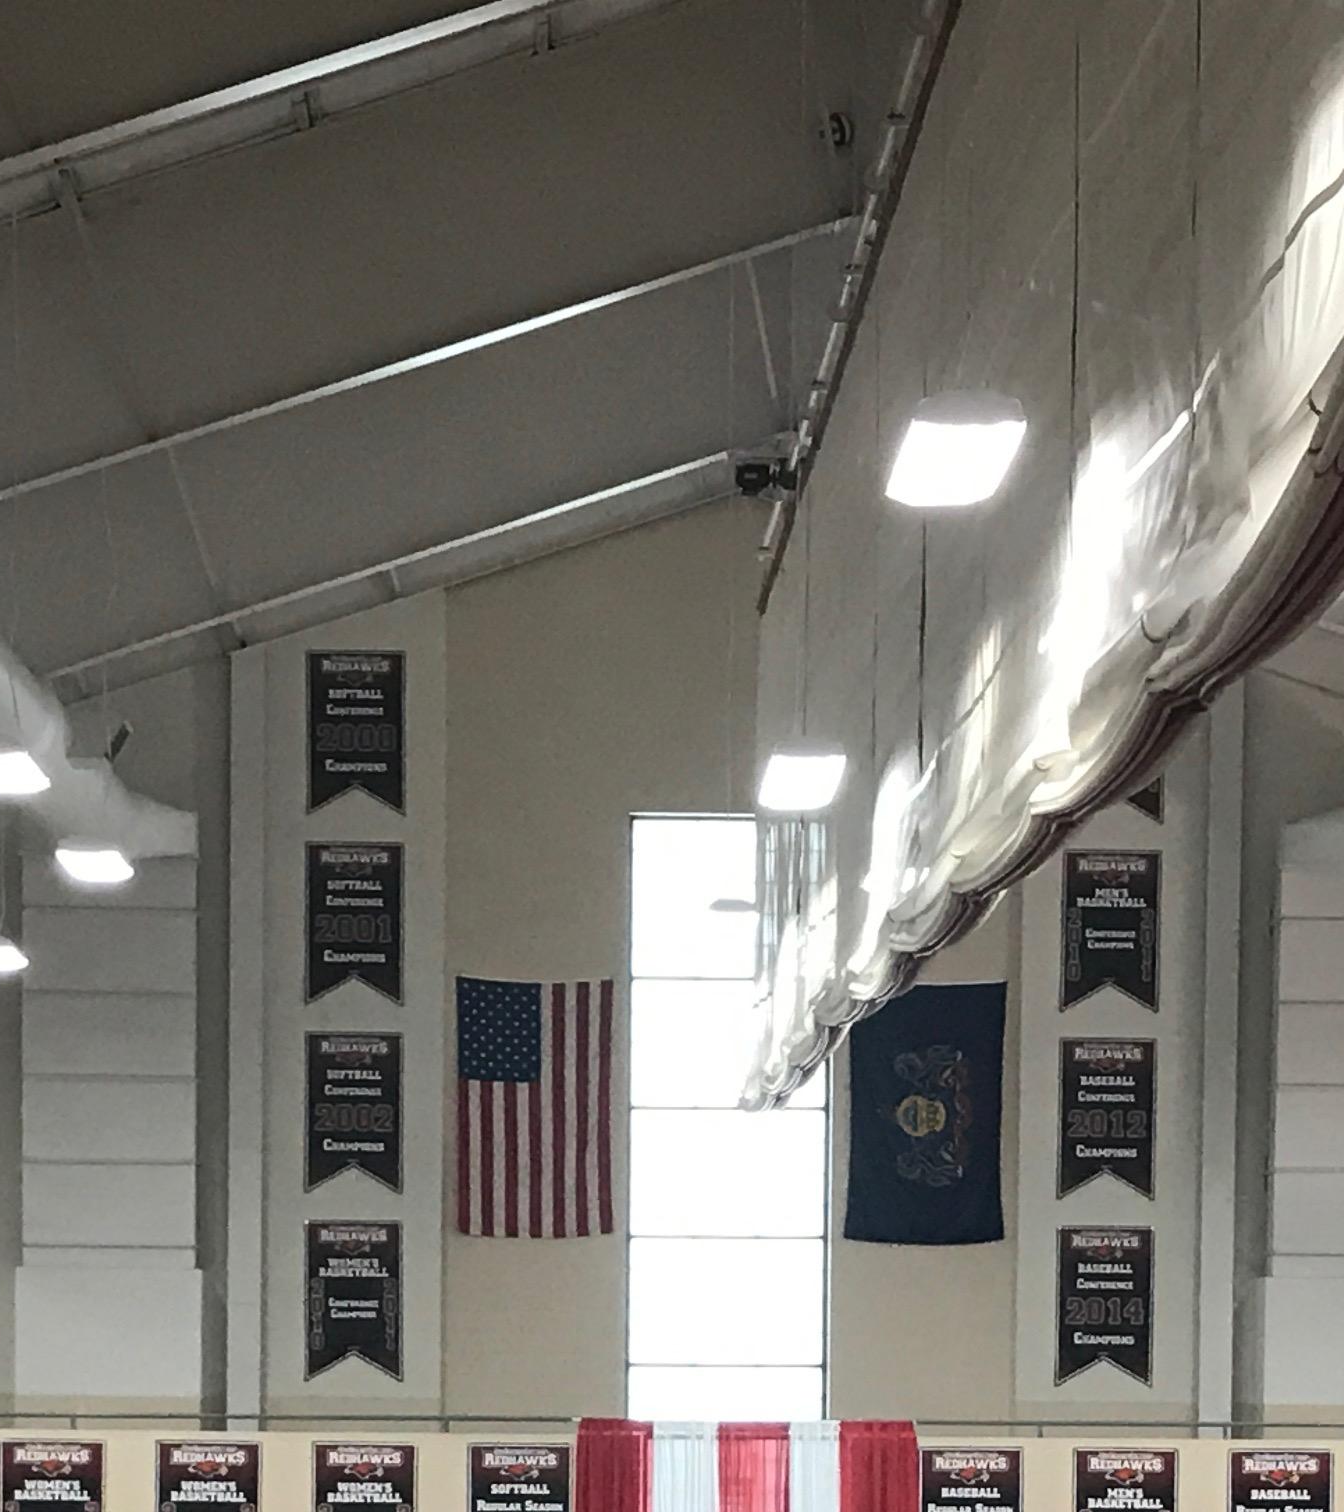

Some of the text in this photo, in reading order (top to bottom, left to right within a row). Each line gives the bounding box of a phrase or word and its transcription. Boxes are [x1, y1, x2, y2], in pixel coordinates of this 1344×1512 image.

[1068, 1110, 1148, 1137] 2012
[1066, 1297, 1145, 1324] 2014
[491, 1484, 550, 1494] SOFTBALL
[941, 1487, 1000, 1498] BASEBALL
[14, 1490, 91, 1501] BASKETBALL
[171, 1492, 246, 1502] BASKETBALL
[328, 1493, 402, 1503] BASKETBALL
[1251, 1490, 1310, 1500] BASEBALL
[1088, 1499, 1163, 1509] BASKETBALL
